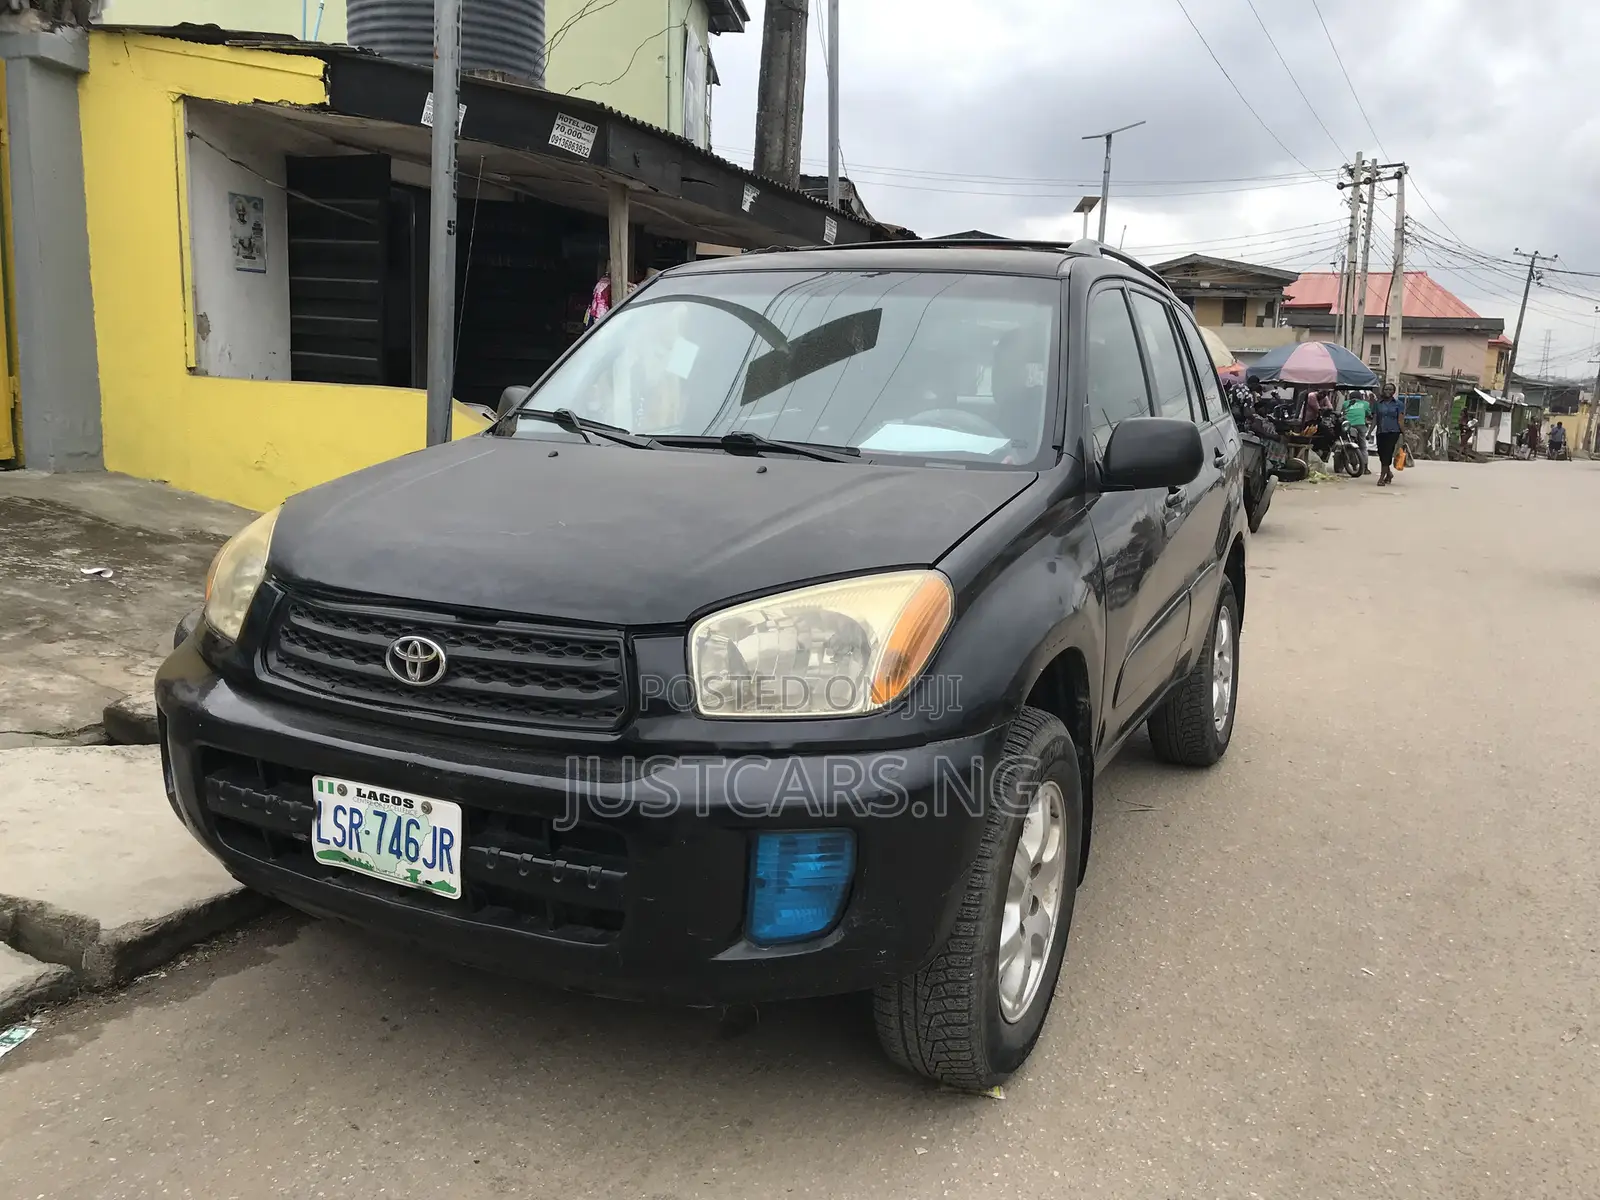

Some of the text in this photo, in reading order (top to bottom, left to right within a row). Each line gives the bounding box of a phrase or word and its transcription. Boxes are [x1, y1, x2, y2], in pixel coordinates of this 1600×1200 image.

[556, 123, 582, 140] 70,000
[558, 114, 580, 128] HOTEL
[581, 123, 596, 134] JOB
[356, 787, 414, 809] LAGOS
